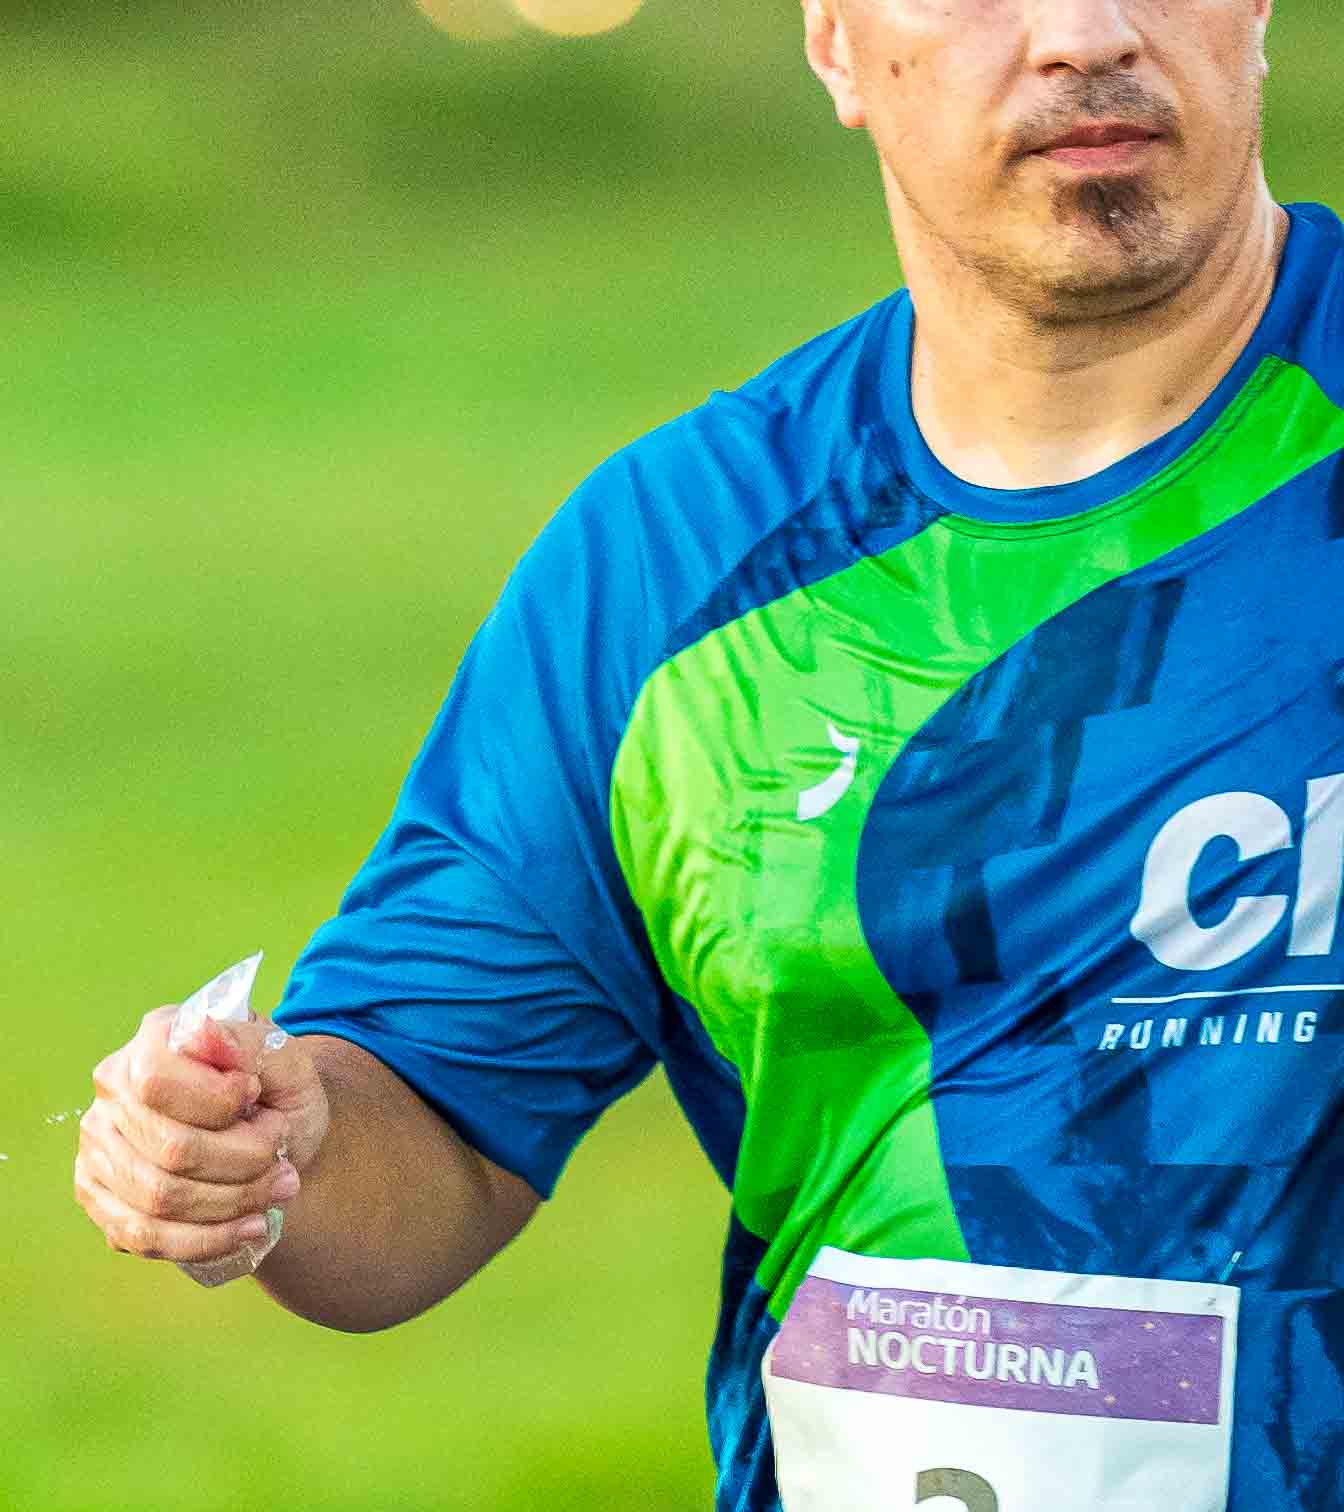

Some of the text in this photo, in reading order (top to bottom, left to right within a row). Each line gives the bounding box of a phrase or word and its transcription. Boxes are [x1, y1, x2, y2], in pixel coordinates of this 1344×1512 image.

[1096, 1009, 1319, 1052] RUNNING
[847, 1289, 992, 1336] Maratón
[847, 1327, 1100, 1390] NOCTURNA
